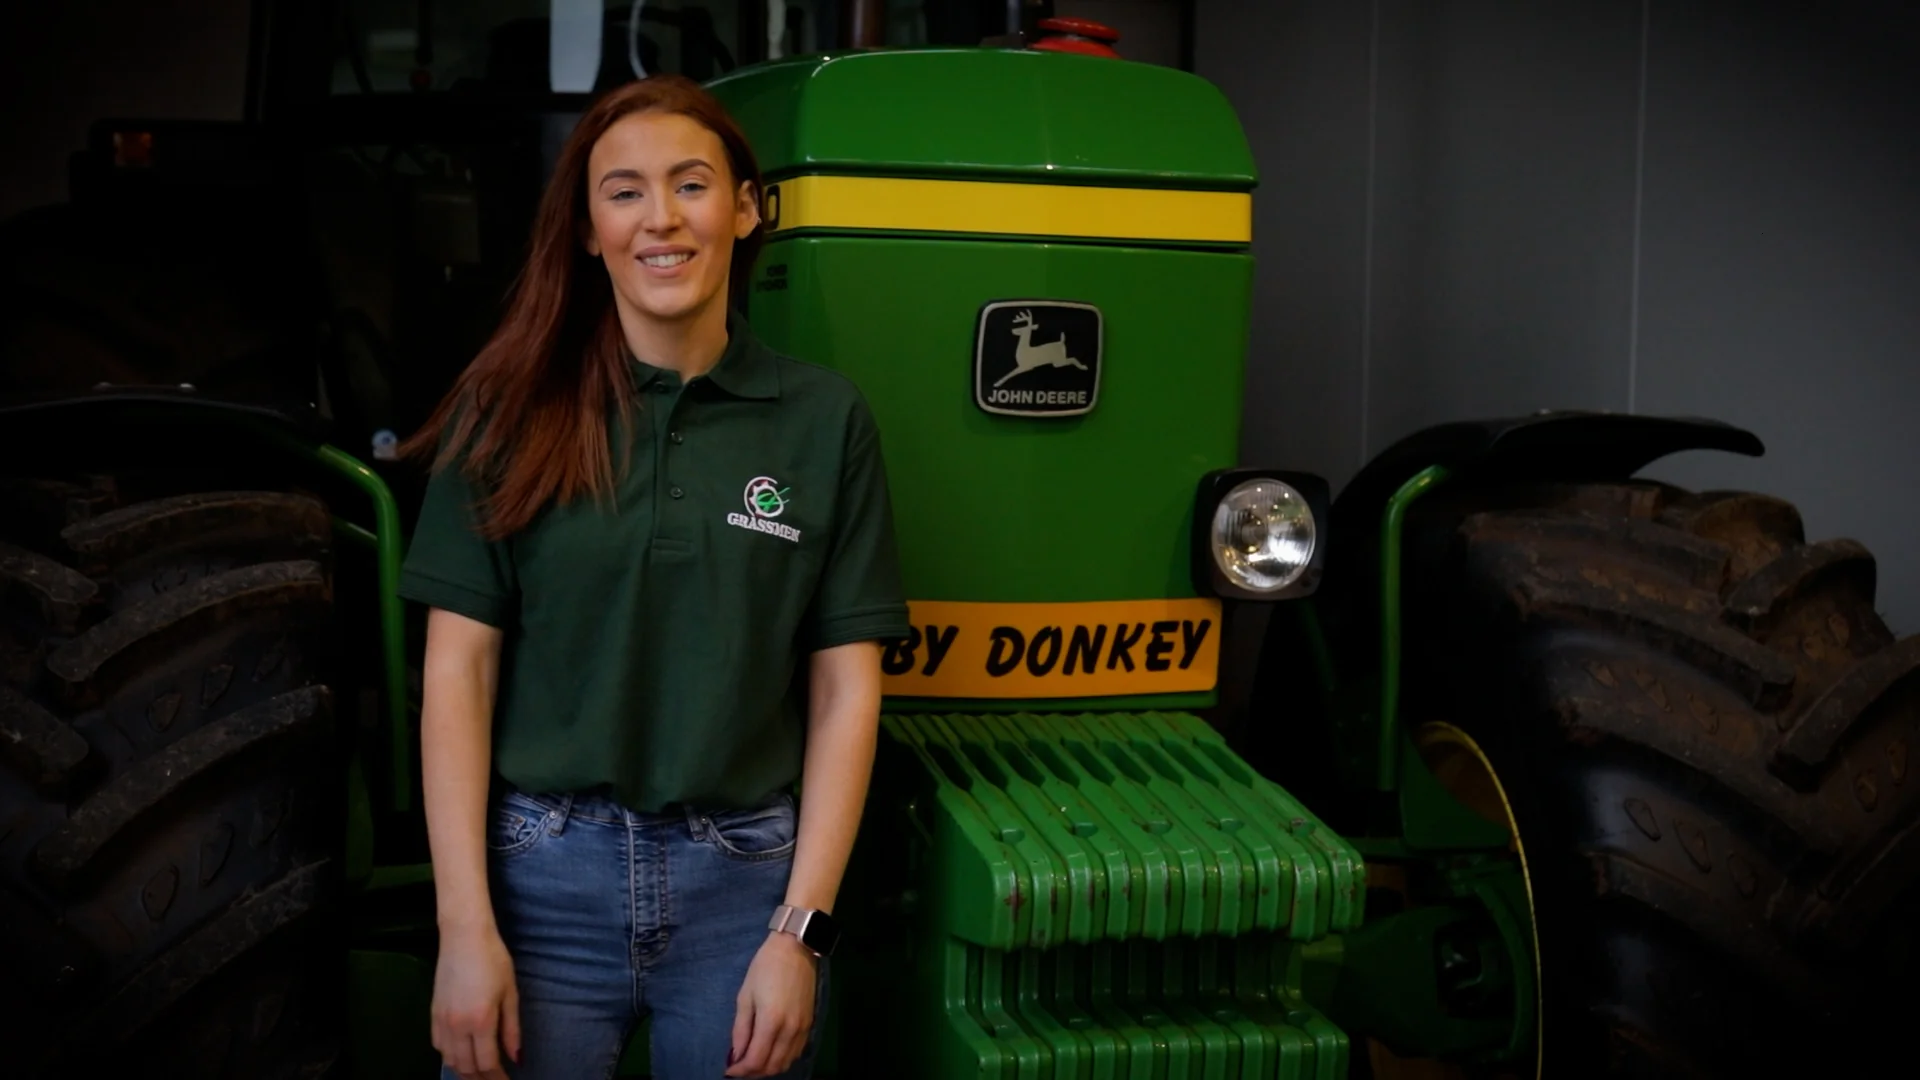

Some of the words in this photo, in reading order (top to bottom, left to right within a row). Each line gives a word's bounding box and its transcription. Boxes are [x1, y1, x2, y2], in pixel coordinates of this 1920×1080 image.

[988, 389, 1033, 404] JOHN
[1036, 391, 1087, 404] DEERE
[726, 512, 801, 543] GRASSMEN
[986, 619, 1212, 677] DONKEY
